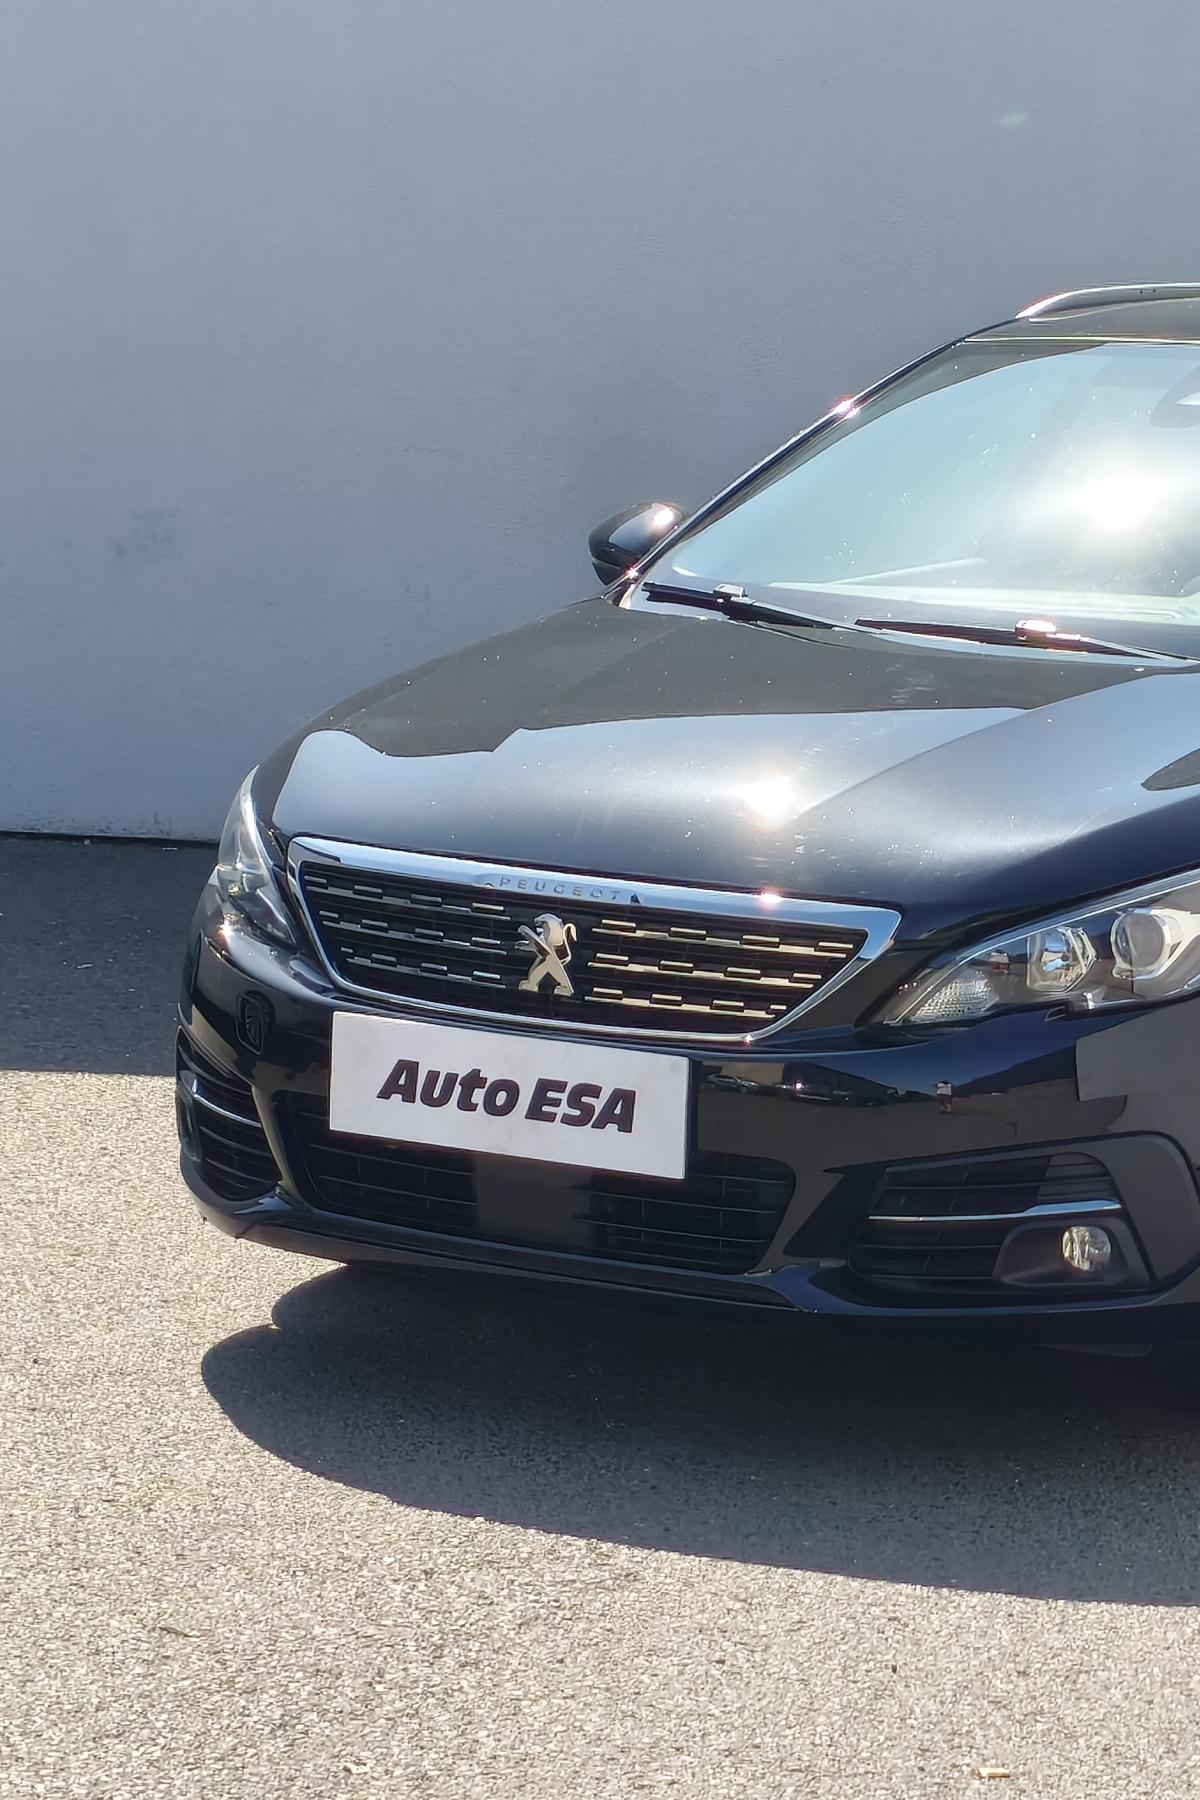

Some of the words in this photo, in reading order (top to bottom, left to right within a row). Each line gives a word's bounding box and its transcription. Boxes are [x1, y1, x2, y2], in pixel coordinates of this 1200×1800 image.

[499, 875, 621, 900] PEUGEOT
[376, 1059, 520, 1117] Auto
[525, 1077, 636, 1133] ESA
